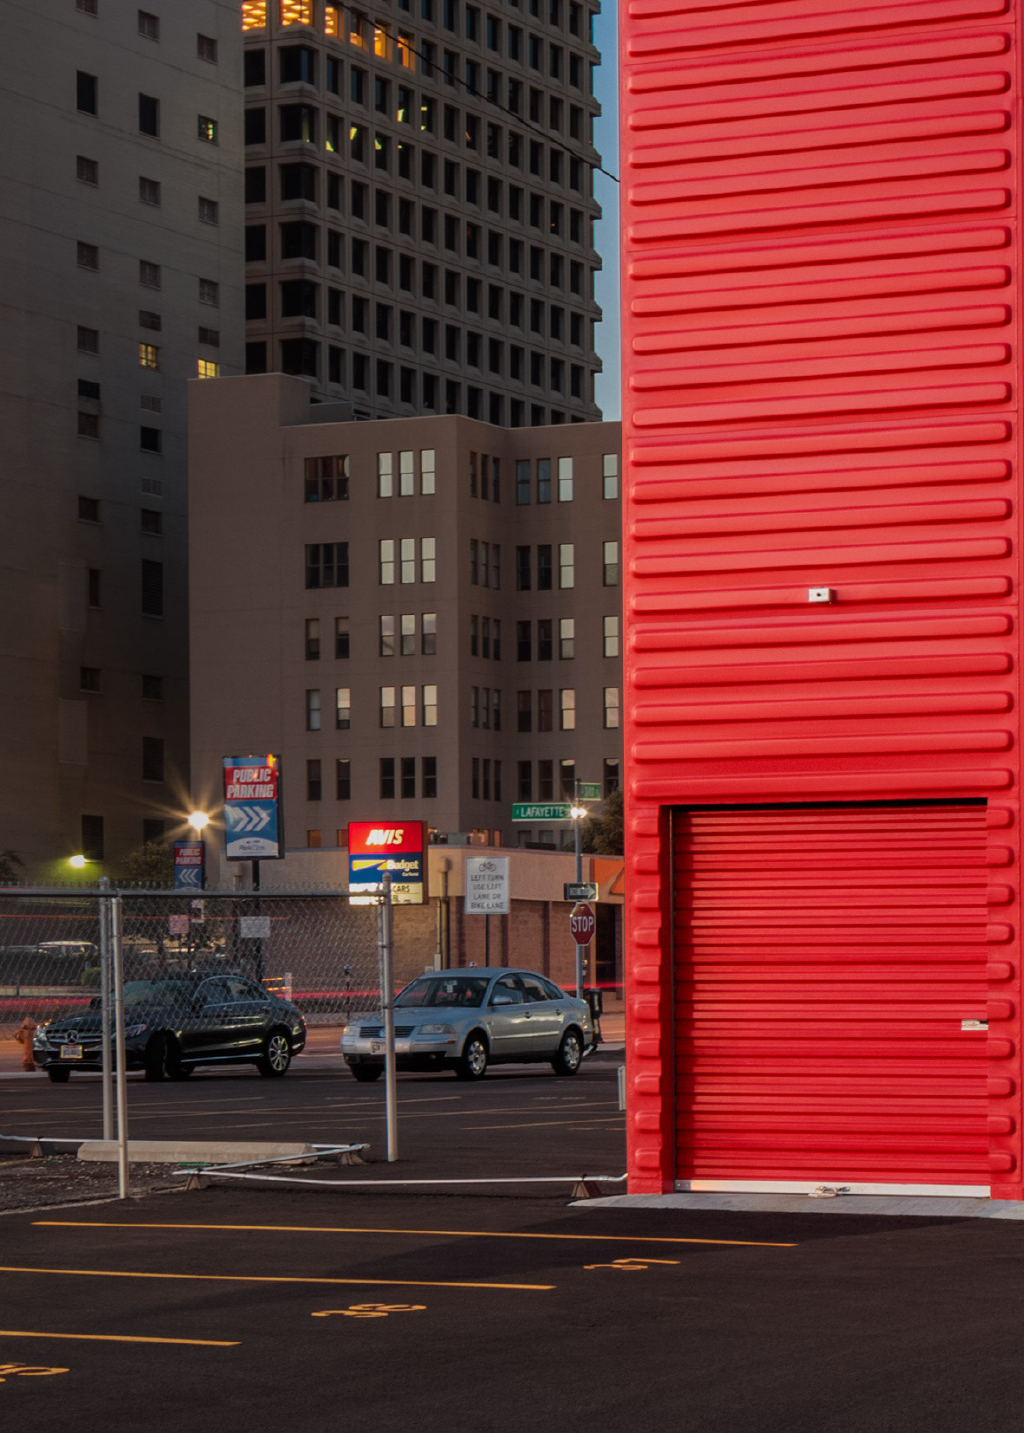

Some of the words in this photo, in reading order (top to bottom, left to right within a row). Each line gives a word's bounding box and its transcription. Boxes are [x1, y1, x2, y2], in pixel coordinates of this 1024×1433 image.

[233, 768, 272, 783] PUBLIC
[226, 784, 274, 798] PARKING
[521, 806, 565, 817] LAFAYETTE
[365, 829, 404, 845] AVIS
[387, 859, 419, 871] Budget
[571, 916, 594, 932] STOP
[311, 1303, 428, 1318] 36
